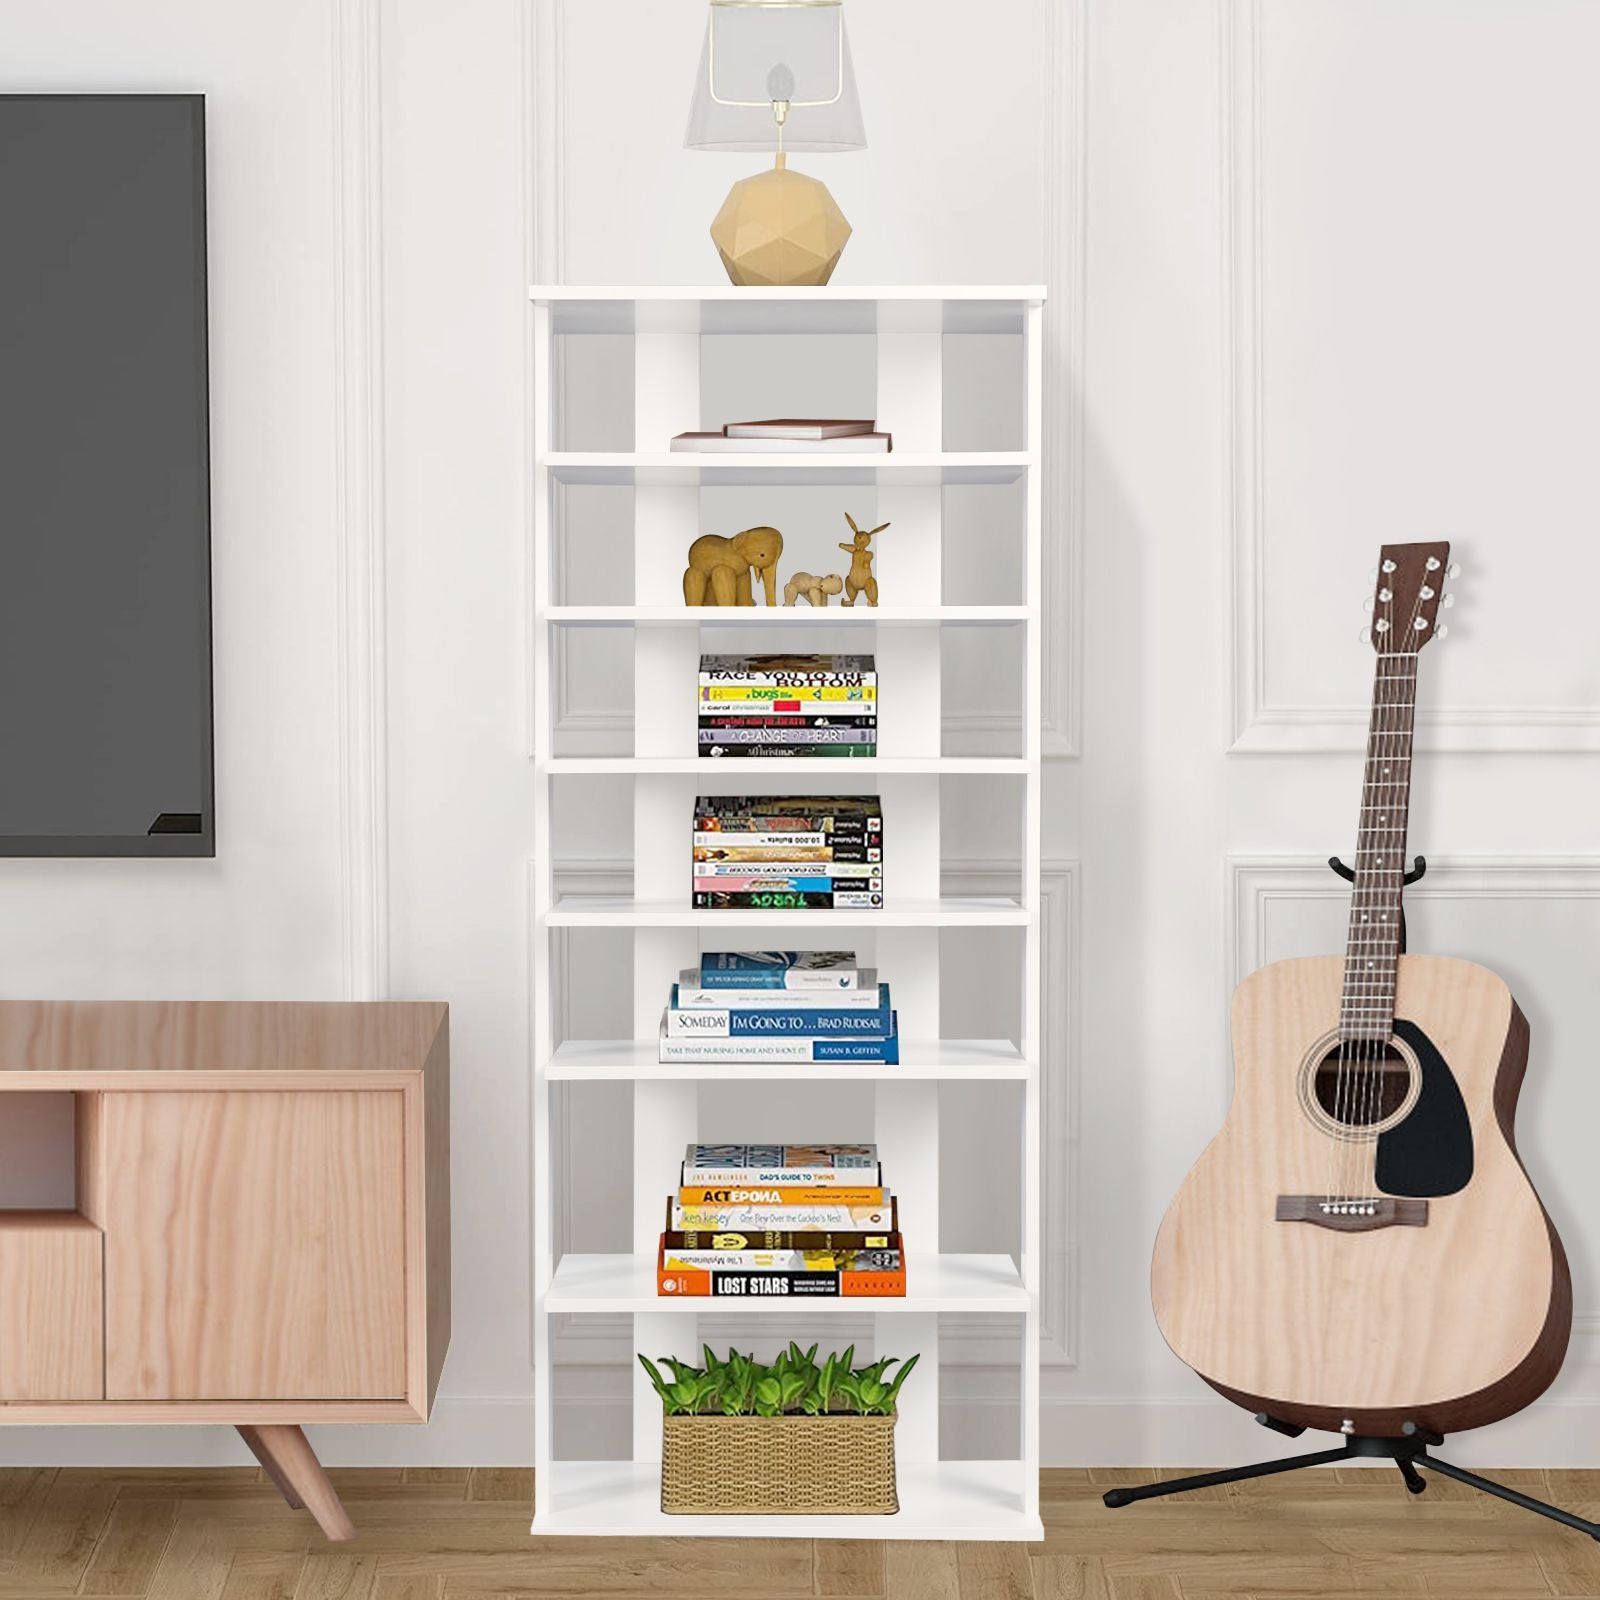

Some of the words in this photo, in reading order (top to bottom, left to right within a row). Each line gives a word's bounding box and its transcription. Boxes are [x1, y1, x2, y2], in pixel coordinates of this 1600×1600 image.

[708, 671, 757, 680] RACE
[763, 671, 794, 680] YOU
[799, 671, 825, 680] TO
[828, 671, 868, 680] THE
[776, 679, 864, 687] BOTTOM
[739, 730, 788, 742] CHANGE
[807, 730, 846, 742] HEART
[678, 1014, 728, 1028] SOMEDAY
[749, 1015, 787, 1029] GOING
[817, 1017, 841, 1029] BRAD
[819, 1047, 845, 1055] SUSAN
[759, 1173, 780, 1181] DAD'S
[781, 1173, 801, 1181] GUIDE
[802, 1173, 812, 1181] TO
[813, 1173, 835, 1181] TWINS
[684, 1211, 701, 1224] ken
[703, 1211, 730, 1227] kesey
[740, 1213, 754, 1224] One
[770, 1213, 786, 1224] Over
[786, 1213, 797, 1224] the
[826, 1213, 842, 1224] Nest
[717, 1277, 749, 1294] LOST
[750, 1277, 789, 1294] STARS
